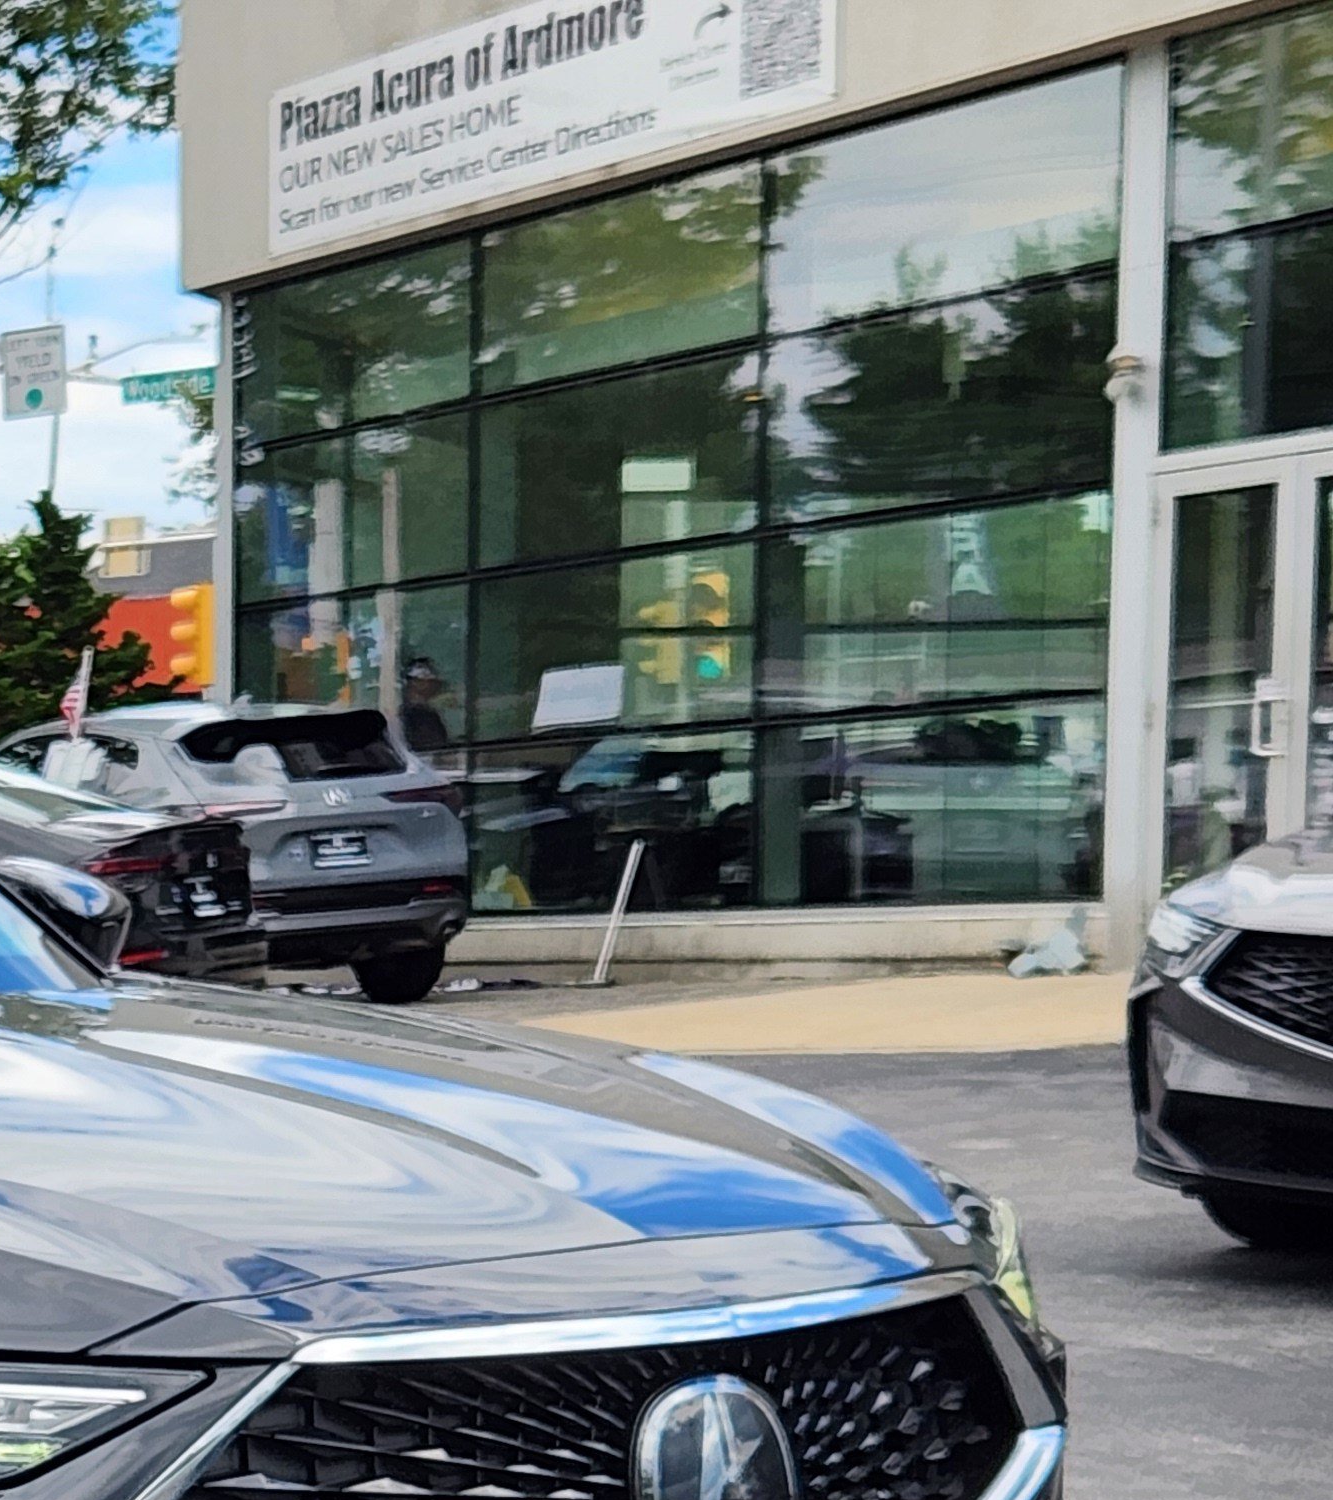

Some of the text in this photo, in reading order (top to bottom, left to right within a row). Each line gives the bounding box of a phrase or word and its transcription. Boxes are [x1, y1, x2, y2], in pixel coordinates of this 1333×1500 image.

[279, 86, 361, 151] Piazza
[369, 54, 455, 123] Acura
[465, 32, 496, 91] of
[501, 0, 644, 81] Ardmore
[279, 94, 522, 193] OUR NEW SALES HOME
[419, 156, 484, 194] Service
[487, 139, 554, 173] Center
[555, 107, 659, 155] Directions
